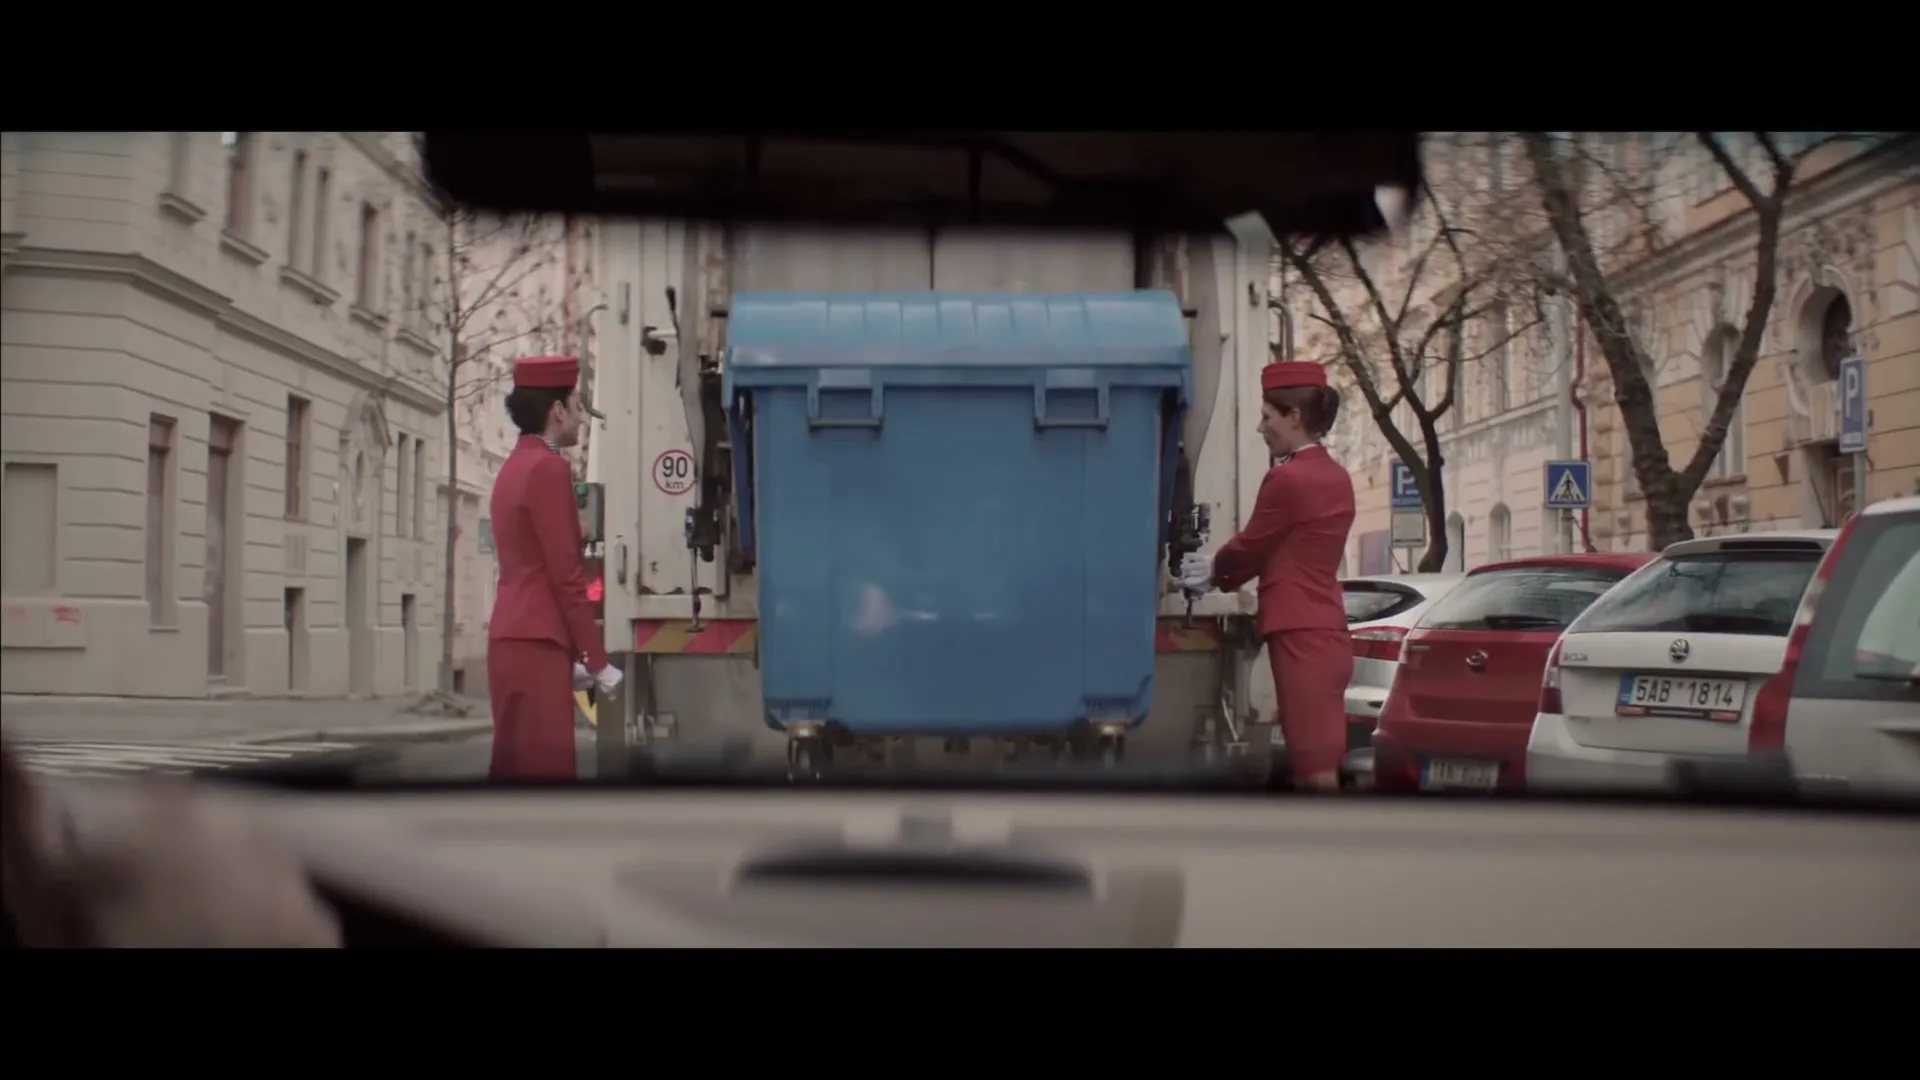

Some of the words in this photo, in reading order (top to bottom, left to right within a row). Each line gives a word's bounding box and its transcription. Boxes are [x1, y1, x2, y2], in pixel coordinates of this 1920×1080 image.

[1845, 366, 1859, 418] P
[662, 456, 688, 478] 90
[1396, 465, 1416, 495] P
[665, 479, 685, 489] km
[1635, 678, 1672, 703] 5AB
[1687, 680, 1733, 707] 1814
